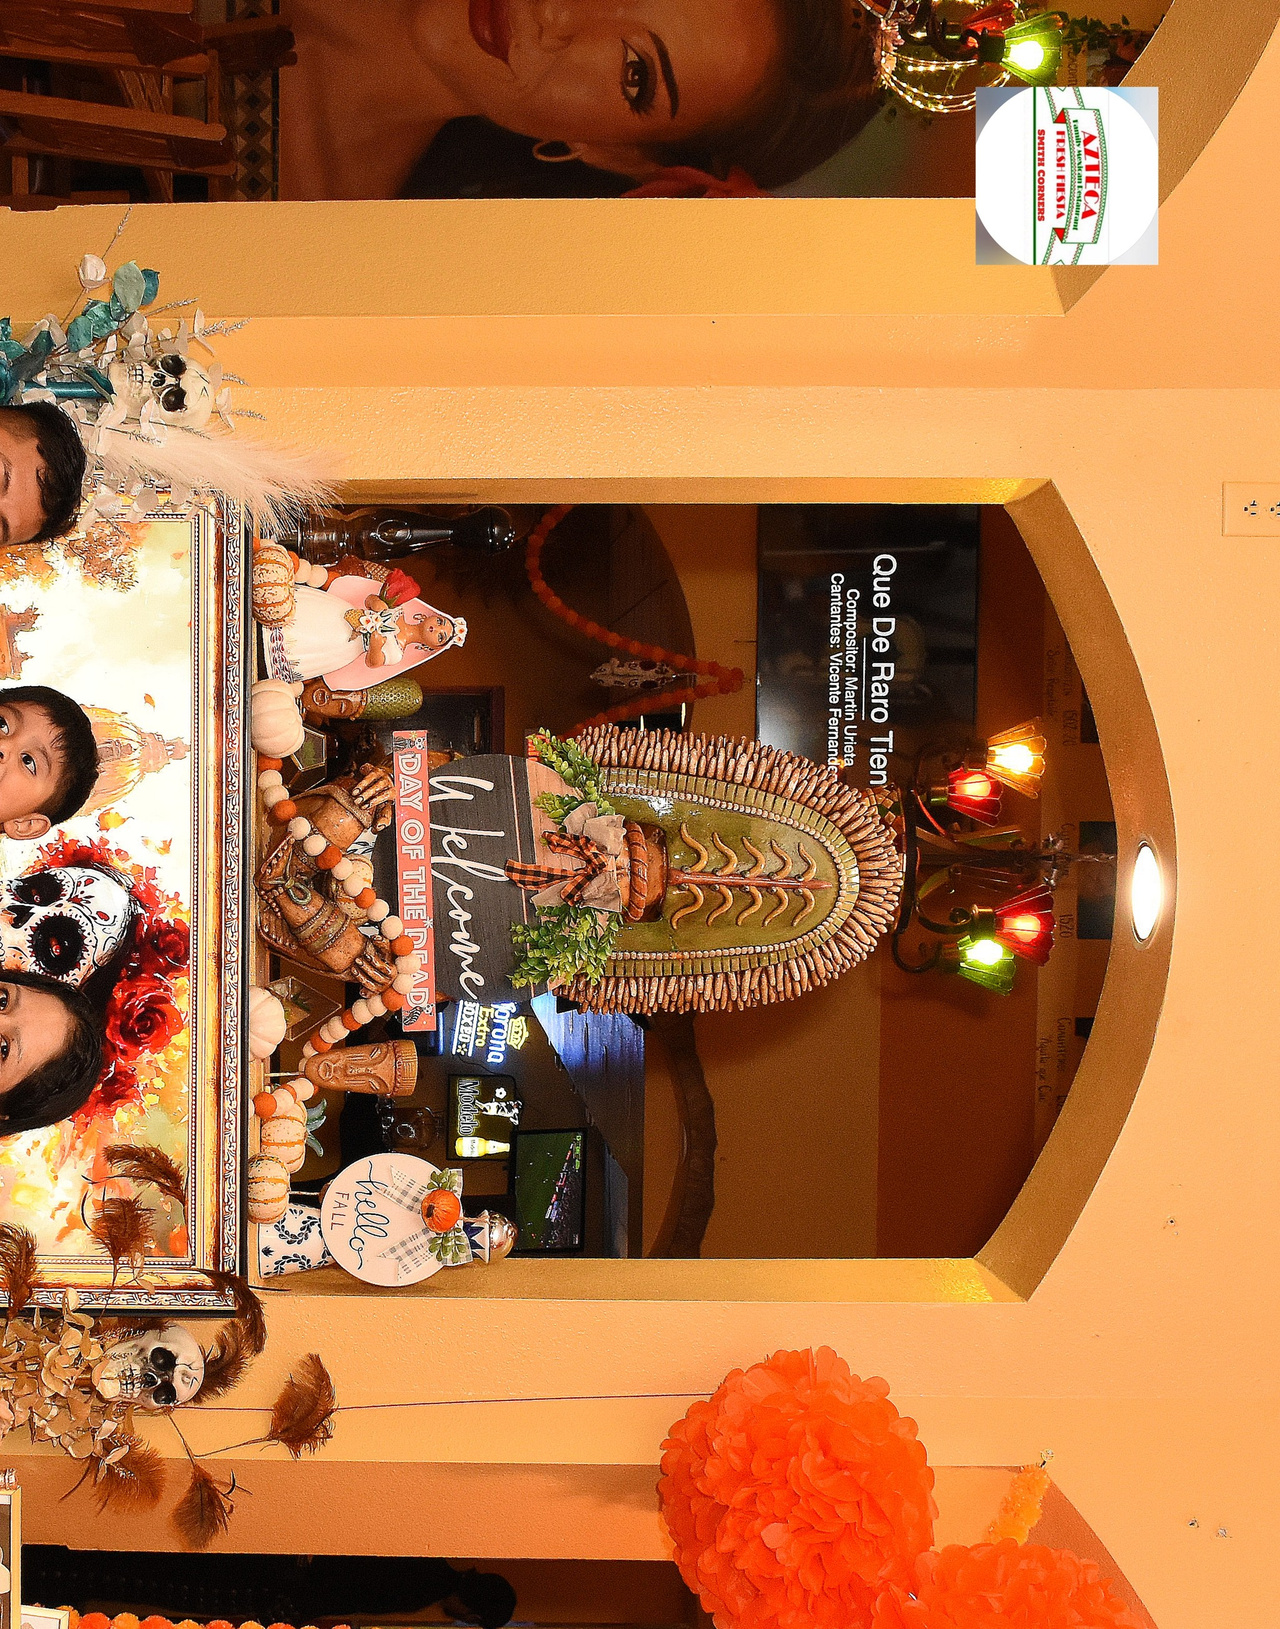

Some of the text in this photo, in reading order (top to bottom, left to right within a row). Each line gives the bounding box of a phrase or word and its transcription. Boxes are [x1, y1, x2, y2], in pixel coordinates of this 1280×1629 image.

[872, 554, 897, 608] Que
[872, 617, 896, 653] De
[827, 573, 845, 782] Cantantes: Vicente Fernande
[843, 588, 860, 767] Compositor: Martin Urieta
[870, 662, 895, 724] Raro
[398, 754, 423, 812] DAY
[400, 818, 425, 860] OF
[402, 867, 427, 926] THE
[428, 775, 510, 1000] Welcome
[457, 1080, 480, 1136] Modelo
[330, 1192, 350, 1231] FALL
[349, 1160, 390, 1270] hello
